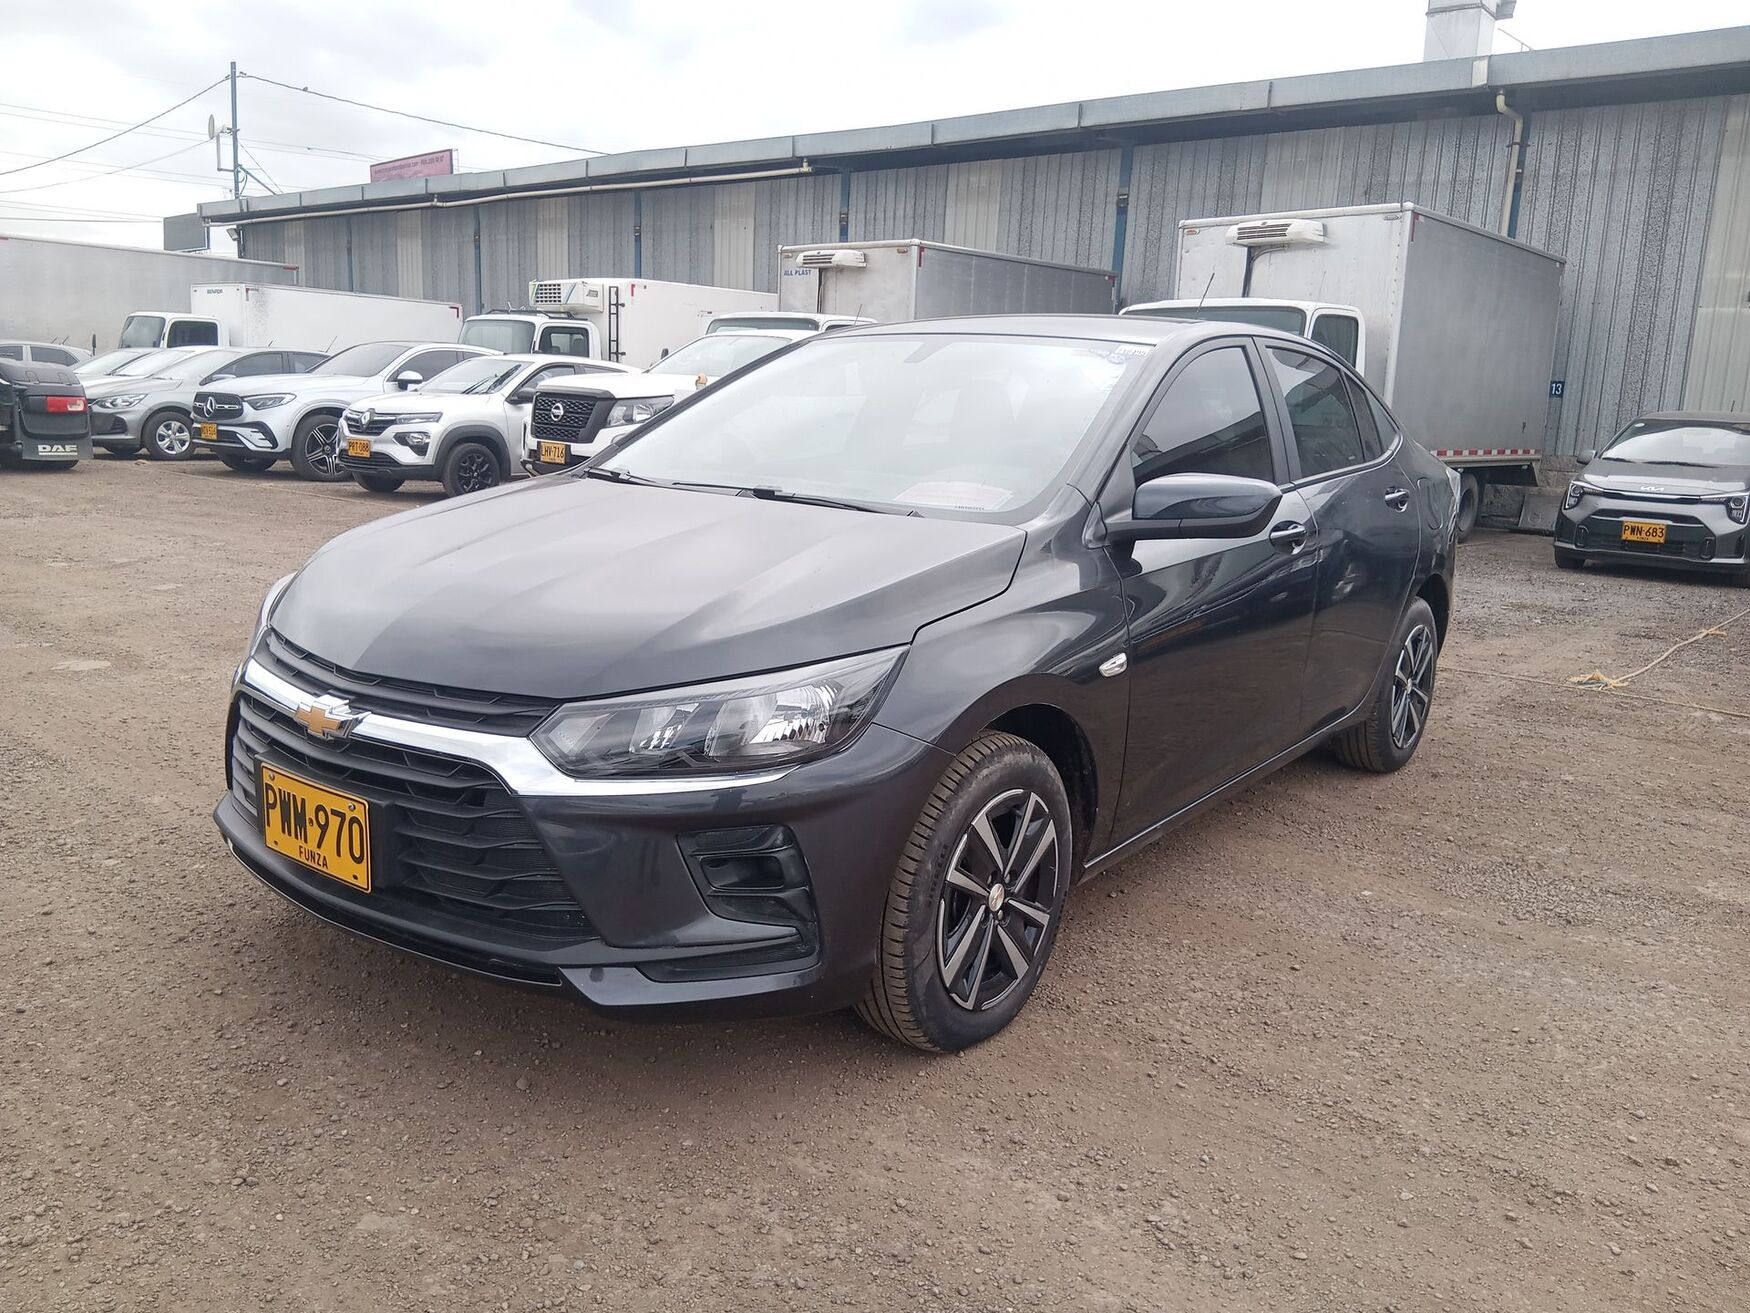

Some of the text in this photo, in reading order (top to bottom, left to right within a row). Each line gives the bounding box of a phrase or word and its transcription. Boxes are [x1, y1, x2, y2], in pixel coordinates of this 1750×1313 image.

[1551, 383, 1562, 395] 13
[38, 444, 78, 453] DAF
[299, 845, 328, 870] FUNZA
